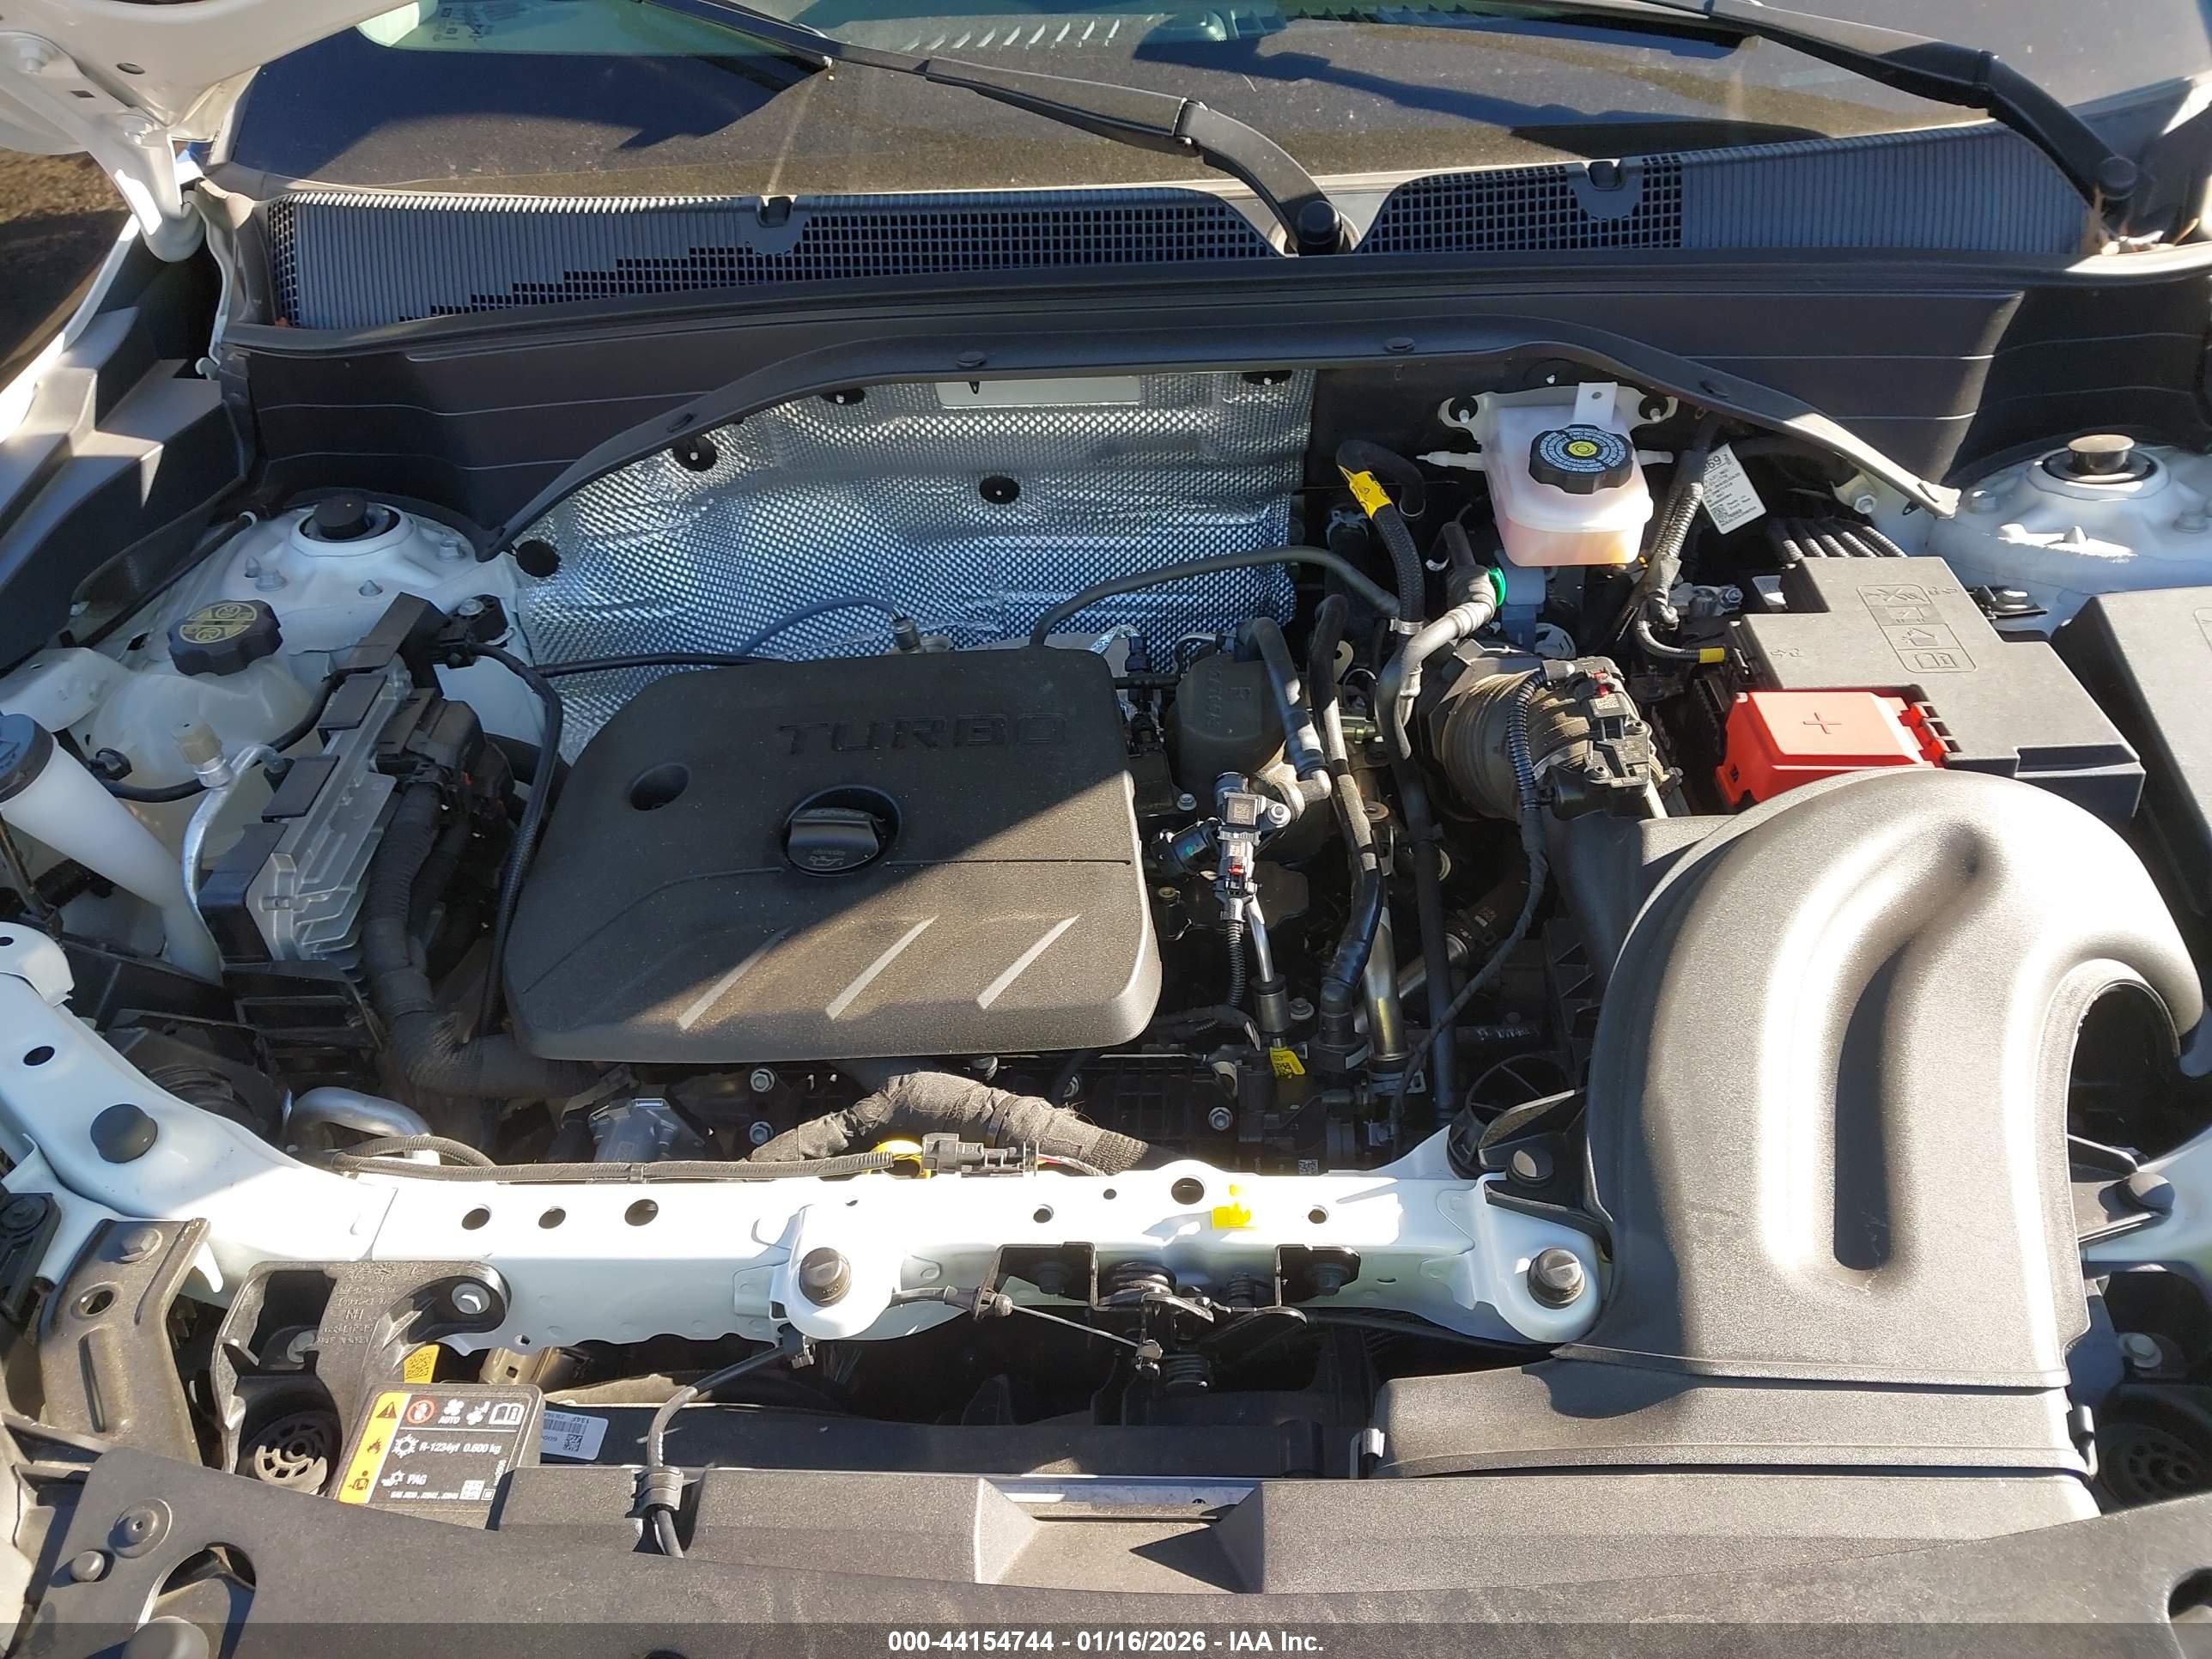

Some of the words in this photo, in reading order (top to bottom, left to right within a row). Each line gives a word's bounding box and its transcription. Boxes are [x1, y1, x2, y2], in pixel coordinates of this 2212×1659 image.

[779, 713, 1067, 756] TURBO
[438, 1415, 461, 1425] AUTO
[418, 1442, 461, 1455] R-1234yf
[463, 1442, 489, 1454] 0.600
[489, 1443, 502, 1455] kg
[406, 1474, 428, 1486] PAG
